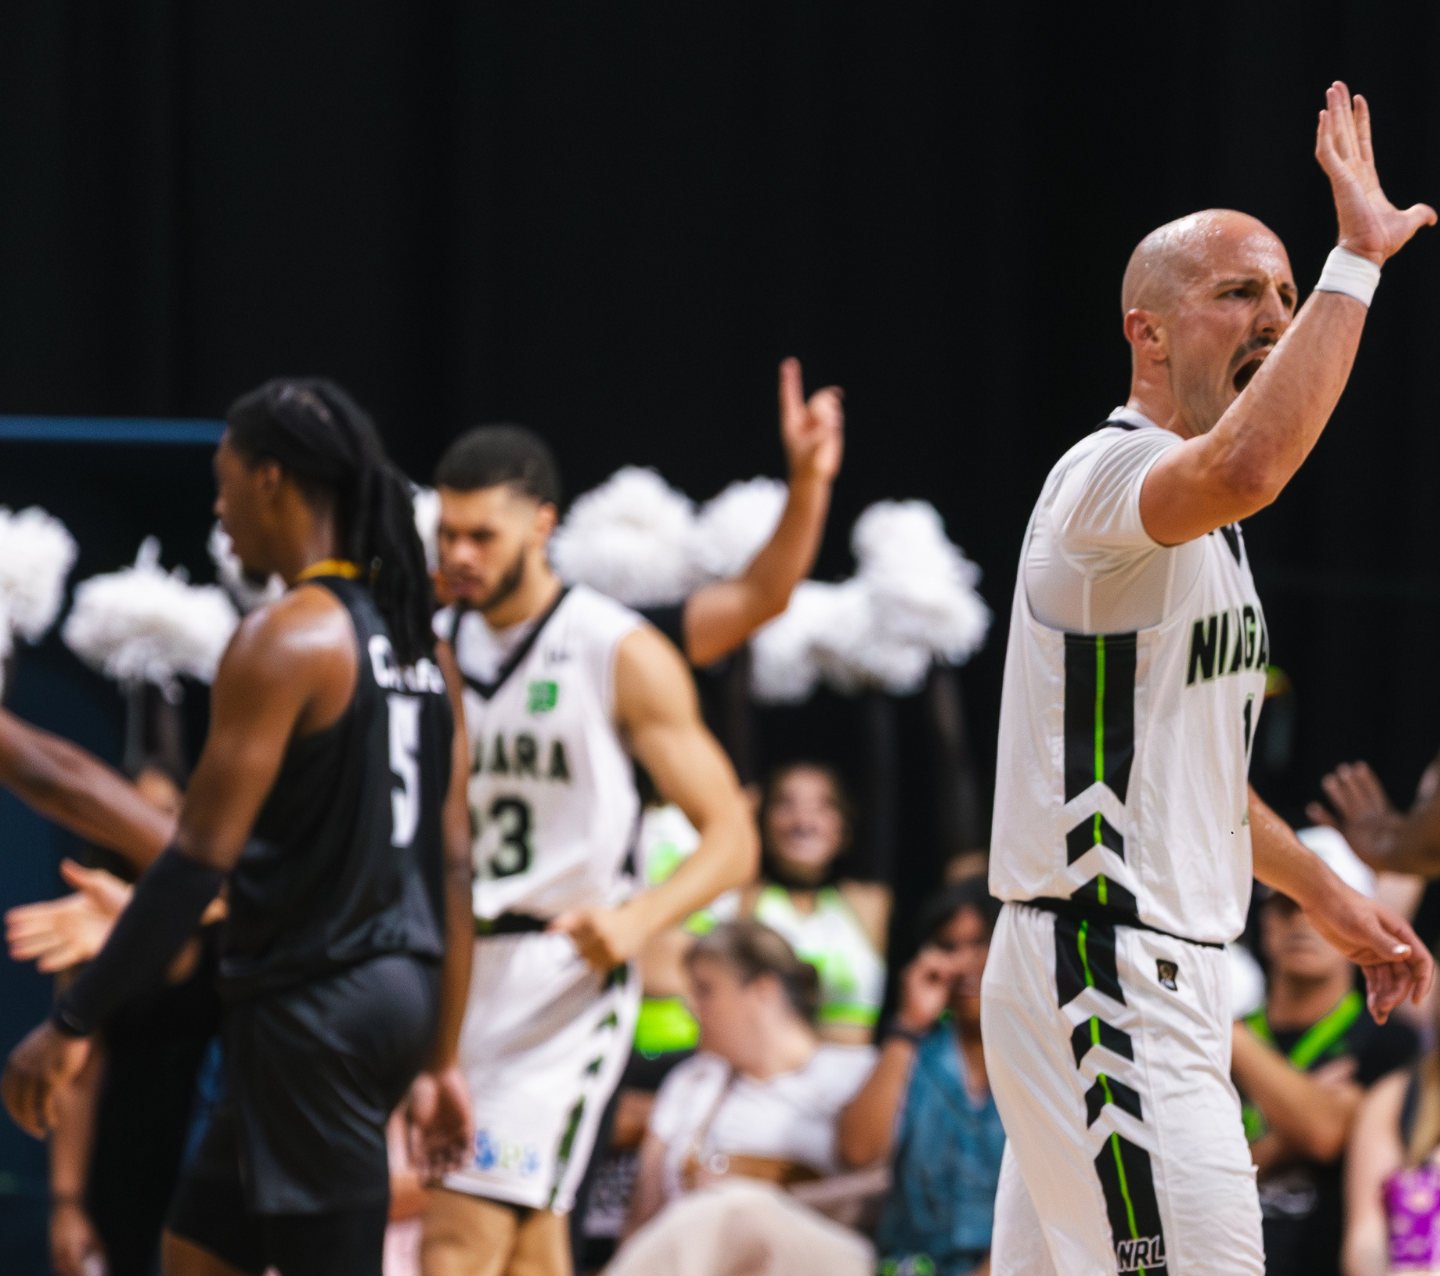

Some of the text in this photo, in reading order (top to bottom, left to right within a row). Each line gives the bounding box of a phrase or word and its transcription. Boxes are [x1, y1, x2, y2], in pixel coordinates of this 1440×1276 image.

[387, 693, 421, 848] 5
[468, 794, 534, 880] 3
[1116, 1234, 1167, 1273] NRL
